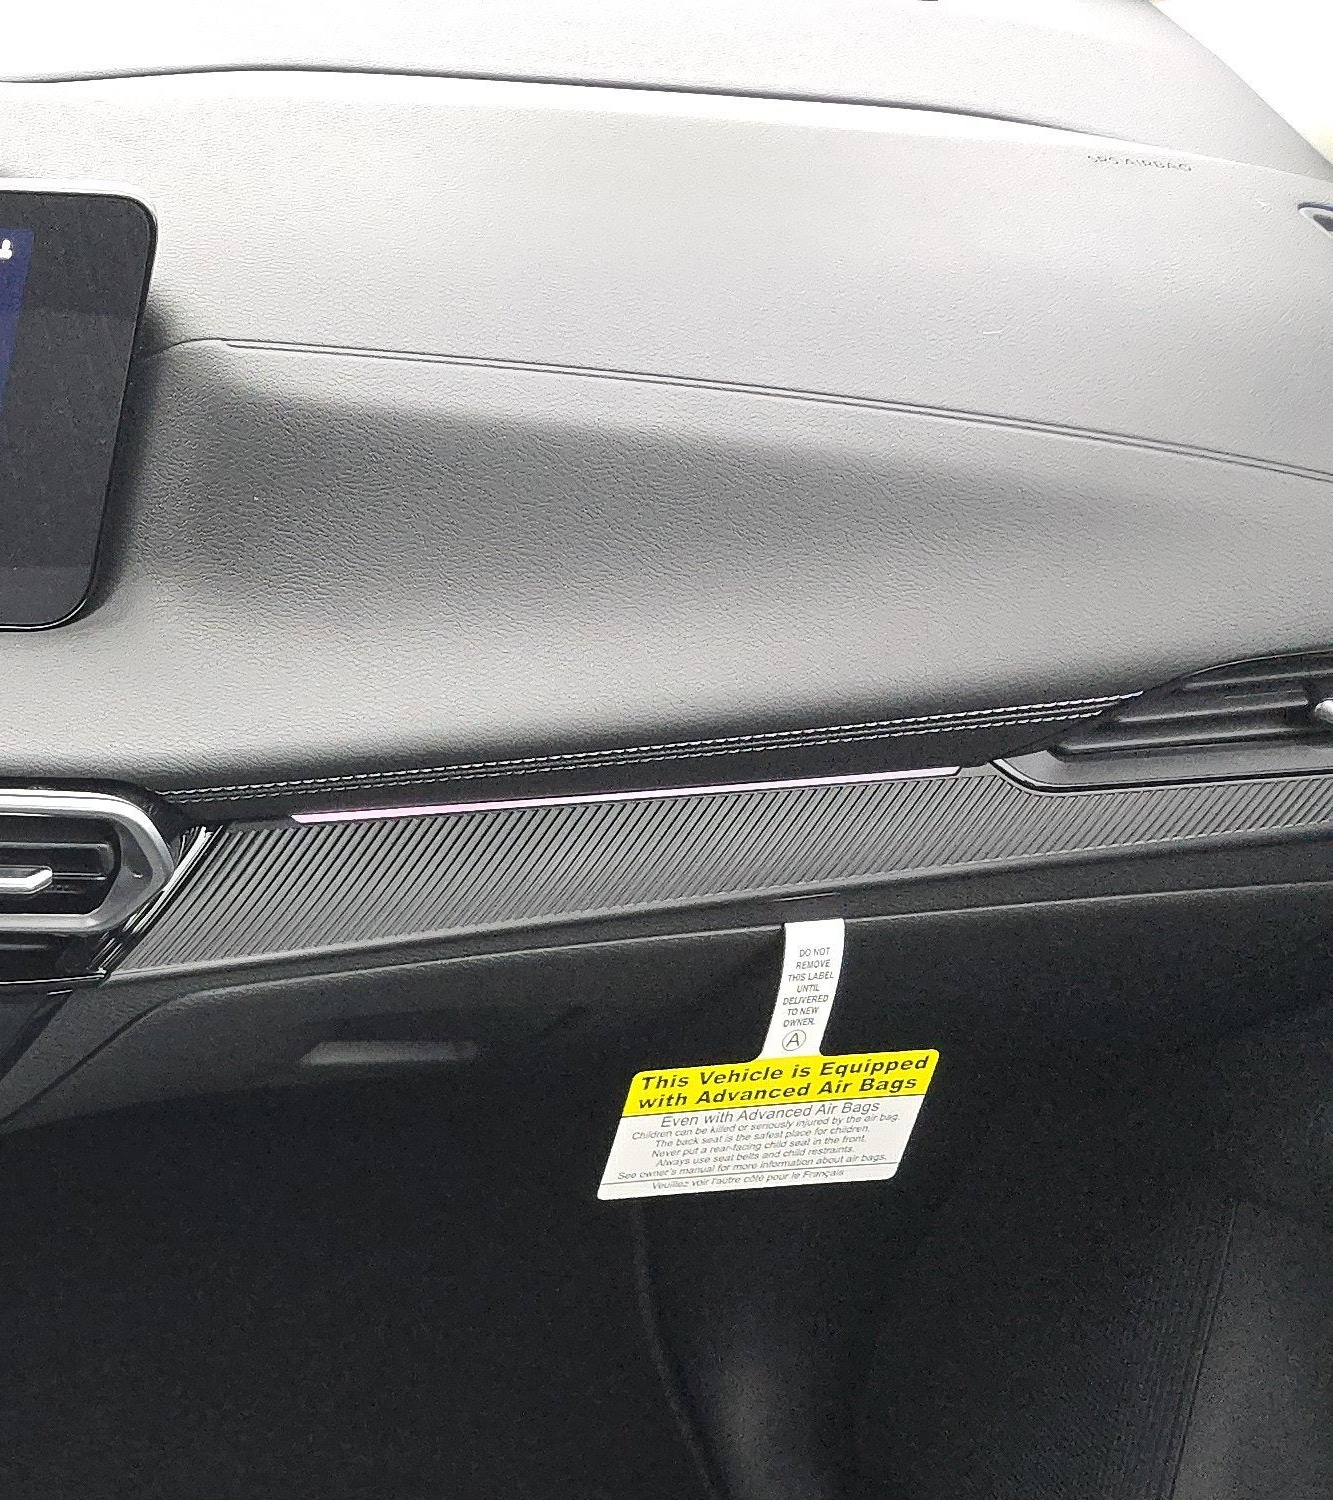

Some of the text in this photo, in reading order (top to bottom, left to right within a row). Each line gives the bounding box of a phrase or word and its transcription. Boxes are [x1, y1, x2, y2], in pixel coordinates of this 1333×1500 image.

[799, 946, 831, 958] DO NOT
[795, 959, 831, 970] REMOVE
[788, 970, 834, 983] THIS LABEL
[796, 984, 820, 993] UNTIL
[783, 994, 829, 1006] DELIVERED
[788, 1006, 820, 1017] TO NEW
[786, 1032, 800, 1048] A
[642, 1055, 930, 1091] This Vehicle is Equipped
[639, 1077, 918, 1109] with Advanced Air Bags
[660, 1101, 881, 1128] Even with Advanced Air Bags
[632, 1129, 673, 1140] Children
[674, 1128, 693, 1137] can
[695, 1126, 708, 1135] be
[710, 1123, 737, 1134] killed
[737, 1124, 749, 1132] or
[750, 1119, 794, 1131] seriously
[795, 1116, 831, 1128] injured
[831, 1116, 844, 1126] by
[846, 1115, 862, 1124] the
[863, 1113, 878, 1123] air
[656, 1139, 674, 1148] The
[675, 1137, 699, 1147] back
[701, 1135, 723, 1144] seat
[724, 1134, 734, 1143] is
[735, 1133, 752, 1142] the
[753, 1130, 784, 1140] safest
[784, 1129, 812, 1139] place
[813, 1127, 828, 1136] for
[651, 1148, 681, 1158] Never
[682, 1147, 699, 1157] put
[710, 1142, 762, 1154] rear-facing
[764, 1140, 788, 1150] child
[788, 1137, 811, 1148] seat
[812, 1137, 822, 1146] in
[824, 1136, 840, 1145] the
[617, 1171, 637, 1180] See
[679, 1164, 716, 1175] manual
[717, 1164, 731, 1172] for
[733, 1163, 758, 1171] more
[760, 1158, 814, 1169] information
[815, 1155, 845, 1165] about
[845, 1154, 860, 1163] air
